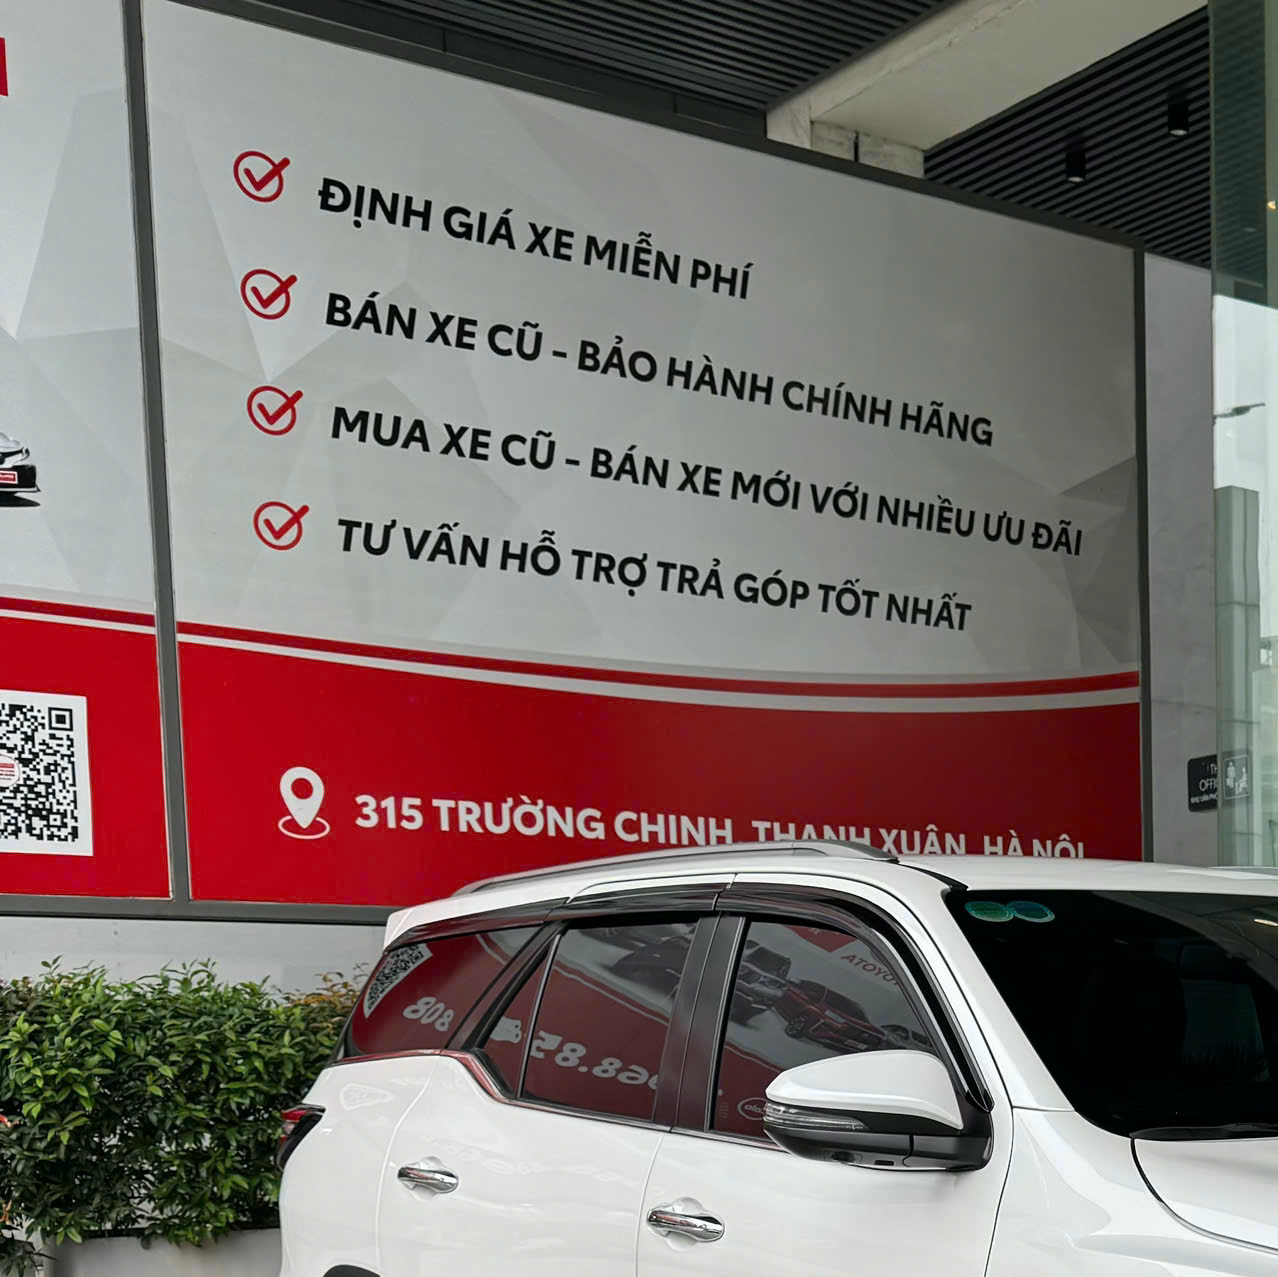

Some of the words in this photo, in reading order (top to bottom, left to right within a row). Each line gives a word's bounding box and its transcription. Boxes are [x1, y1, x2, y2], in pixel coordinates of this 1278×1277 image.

[317, 177, 432, 229] ĐỊNH
[443, 208, 516, 250] GIÁ
[524, 221, 575, 262] XE
[583, 231, 681, 285] MIỄN
[689, 258, 754, 300] PHÍ
[325, 292, 417, 340] BÁN
[425, 311, 478, 351] XE
[487, 321, 543, 361] CŨ
[577, 335, 658, 382] BẢO
[666, 354, 774, 405] HÀNH
[782, 380, 892, 427] CHÍNH
[899, 400, 994, 446] HÃNG
[331, 405, 431, 452] MUA
[439, 423, 492, 462] XE
[500, 430, 556, 470] CŨ
[589, 445, 670, 489] BÁN
[676, 461, 723, 498] XE
[730, 469, 801, 510] MỚI
[810, 482, 869, 522] VỚI
[876, 494, 976, 538] NHIỀU
[982, 510, 1026, 546] ƯU
[1031, 520, 1082, 557] ĐÃI
[338, 518, 397, 555] TƯ
[403, 522, 490, 568] VẤN
[499, 529, 561, 577] HỖ
[571, 549, 648, 597] TRỢ
[656, 558, 724, 600] TRẢ
[733, 569, 810, 610] GÓP
[818, 579, 880, 619] TỐT
[885, 593, 972, 631] NHẤT
[355, 794, 424, 830] 315
[432, 795, 606, 840] TRƯỜNG
[614, 811, 734, 845] CHINH
[879, 825, 966, 857] XUÂN
[983, 831, 1025, 857] HÀ
